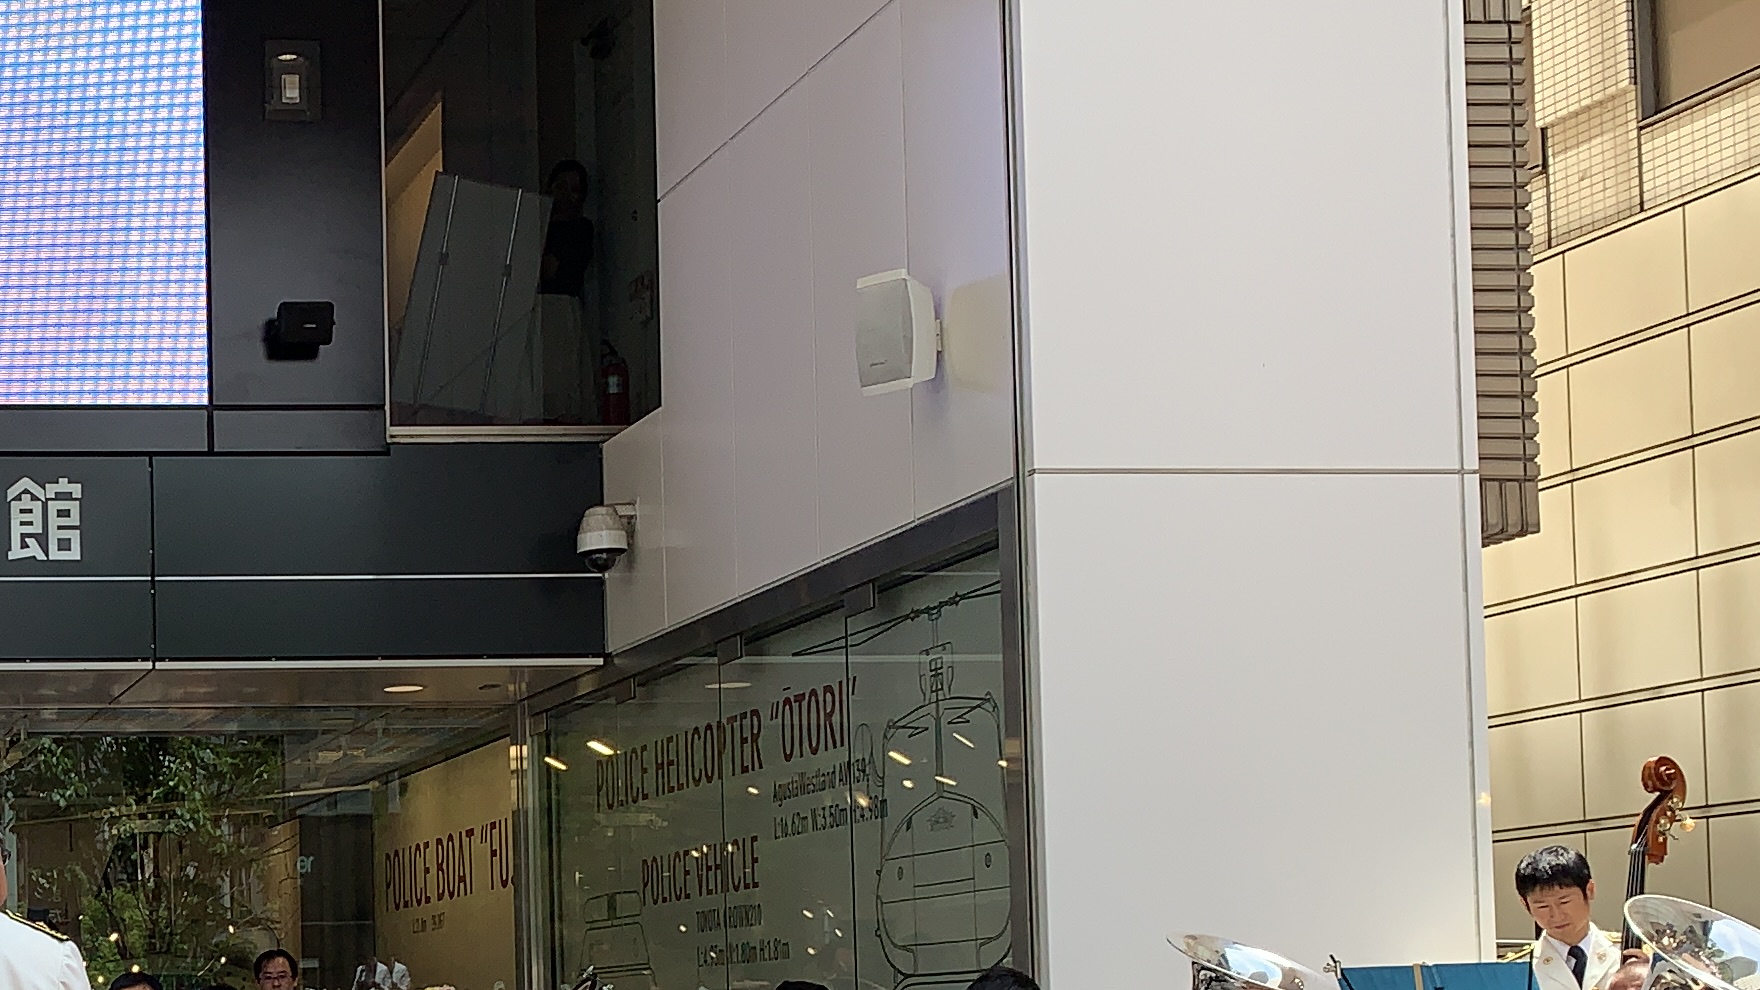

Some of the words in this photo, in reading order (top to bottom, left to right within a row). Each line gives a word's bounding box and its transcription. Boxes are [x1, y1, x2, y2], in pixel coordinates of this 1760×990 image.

[596, 743, 649, 813] POLICE
[654, 708, 764, 798] HELICOPTER
[385, 840, 432, 913] POLICE
[435, 827, 475, 902] BOAT
[480, 817, 515, 891] "FU
[641, 849, 691, 907] POLICE
[694, 834, 759, 897] VEHICLE
[724, 902, 763, 930] ROWN210
